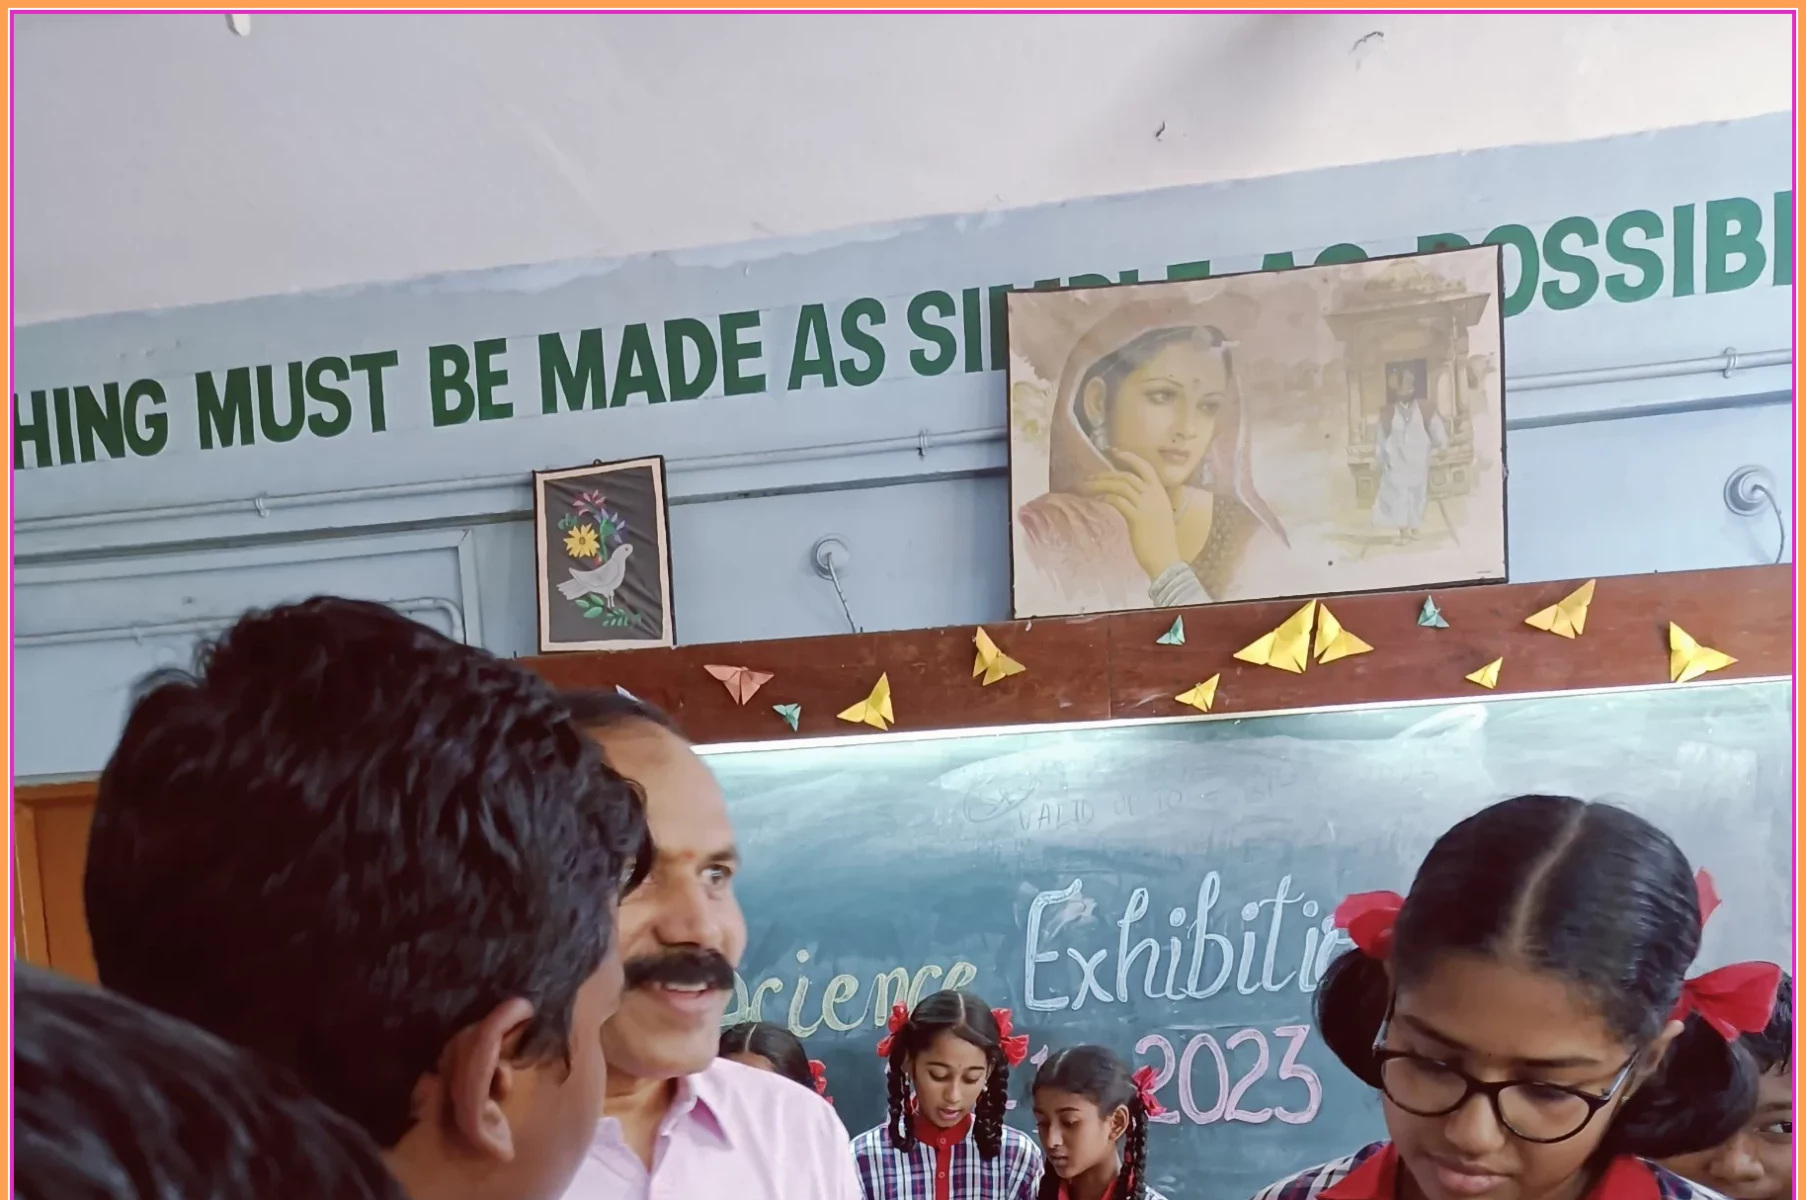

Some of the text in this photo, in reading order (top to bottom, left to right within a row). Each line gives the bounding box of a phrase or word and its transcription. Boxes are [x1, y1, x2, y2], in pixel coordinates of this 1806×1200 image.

[14, 381, 168, 470] HING
[195, 350, 398, 450] MUST
[429, 337, 514, 428] BE
[538, 309, 767, 415] MADE
[787, 297, 886, 391] AS
[1018, 799, 1095, 831] VALID
[1135, 1024, 1322, 1125] 2023
